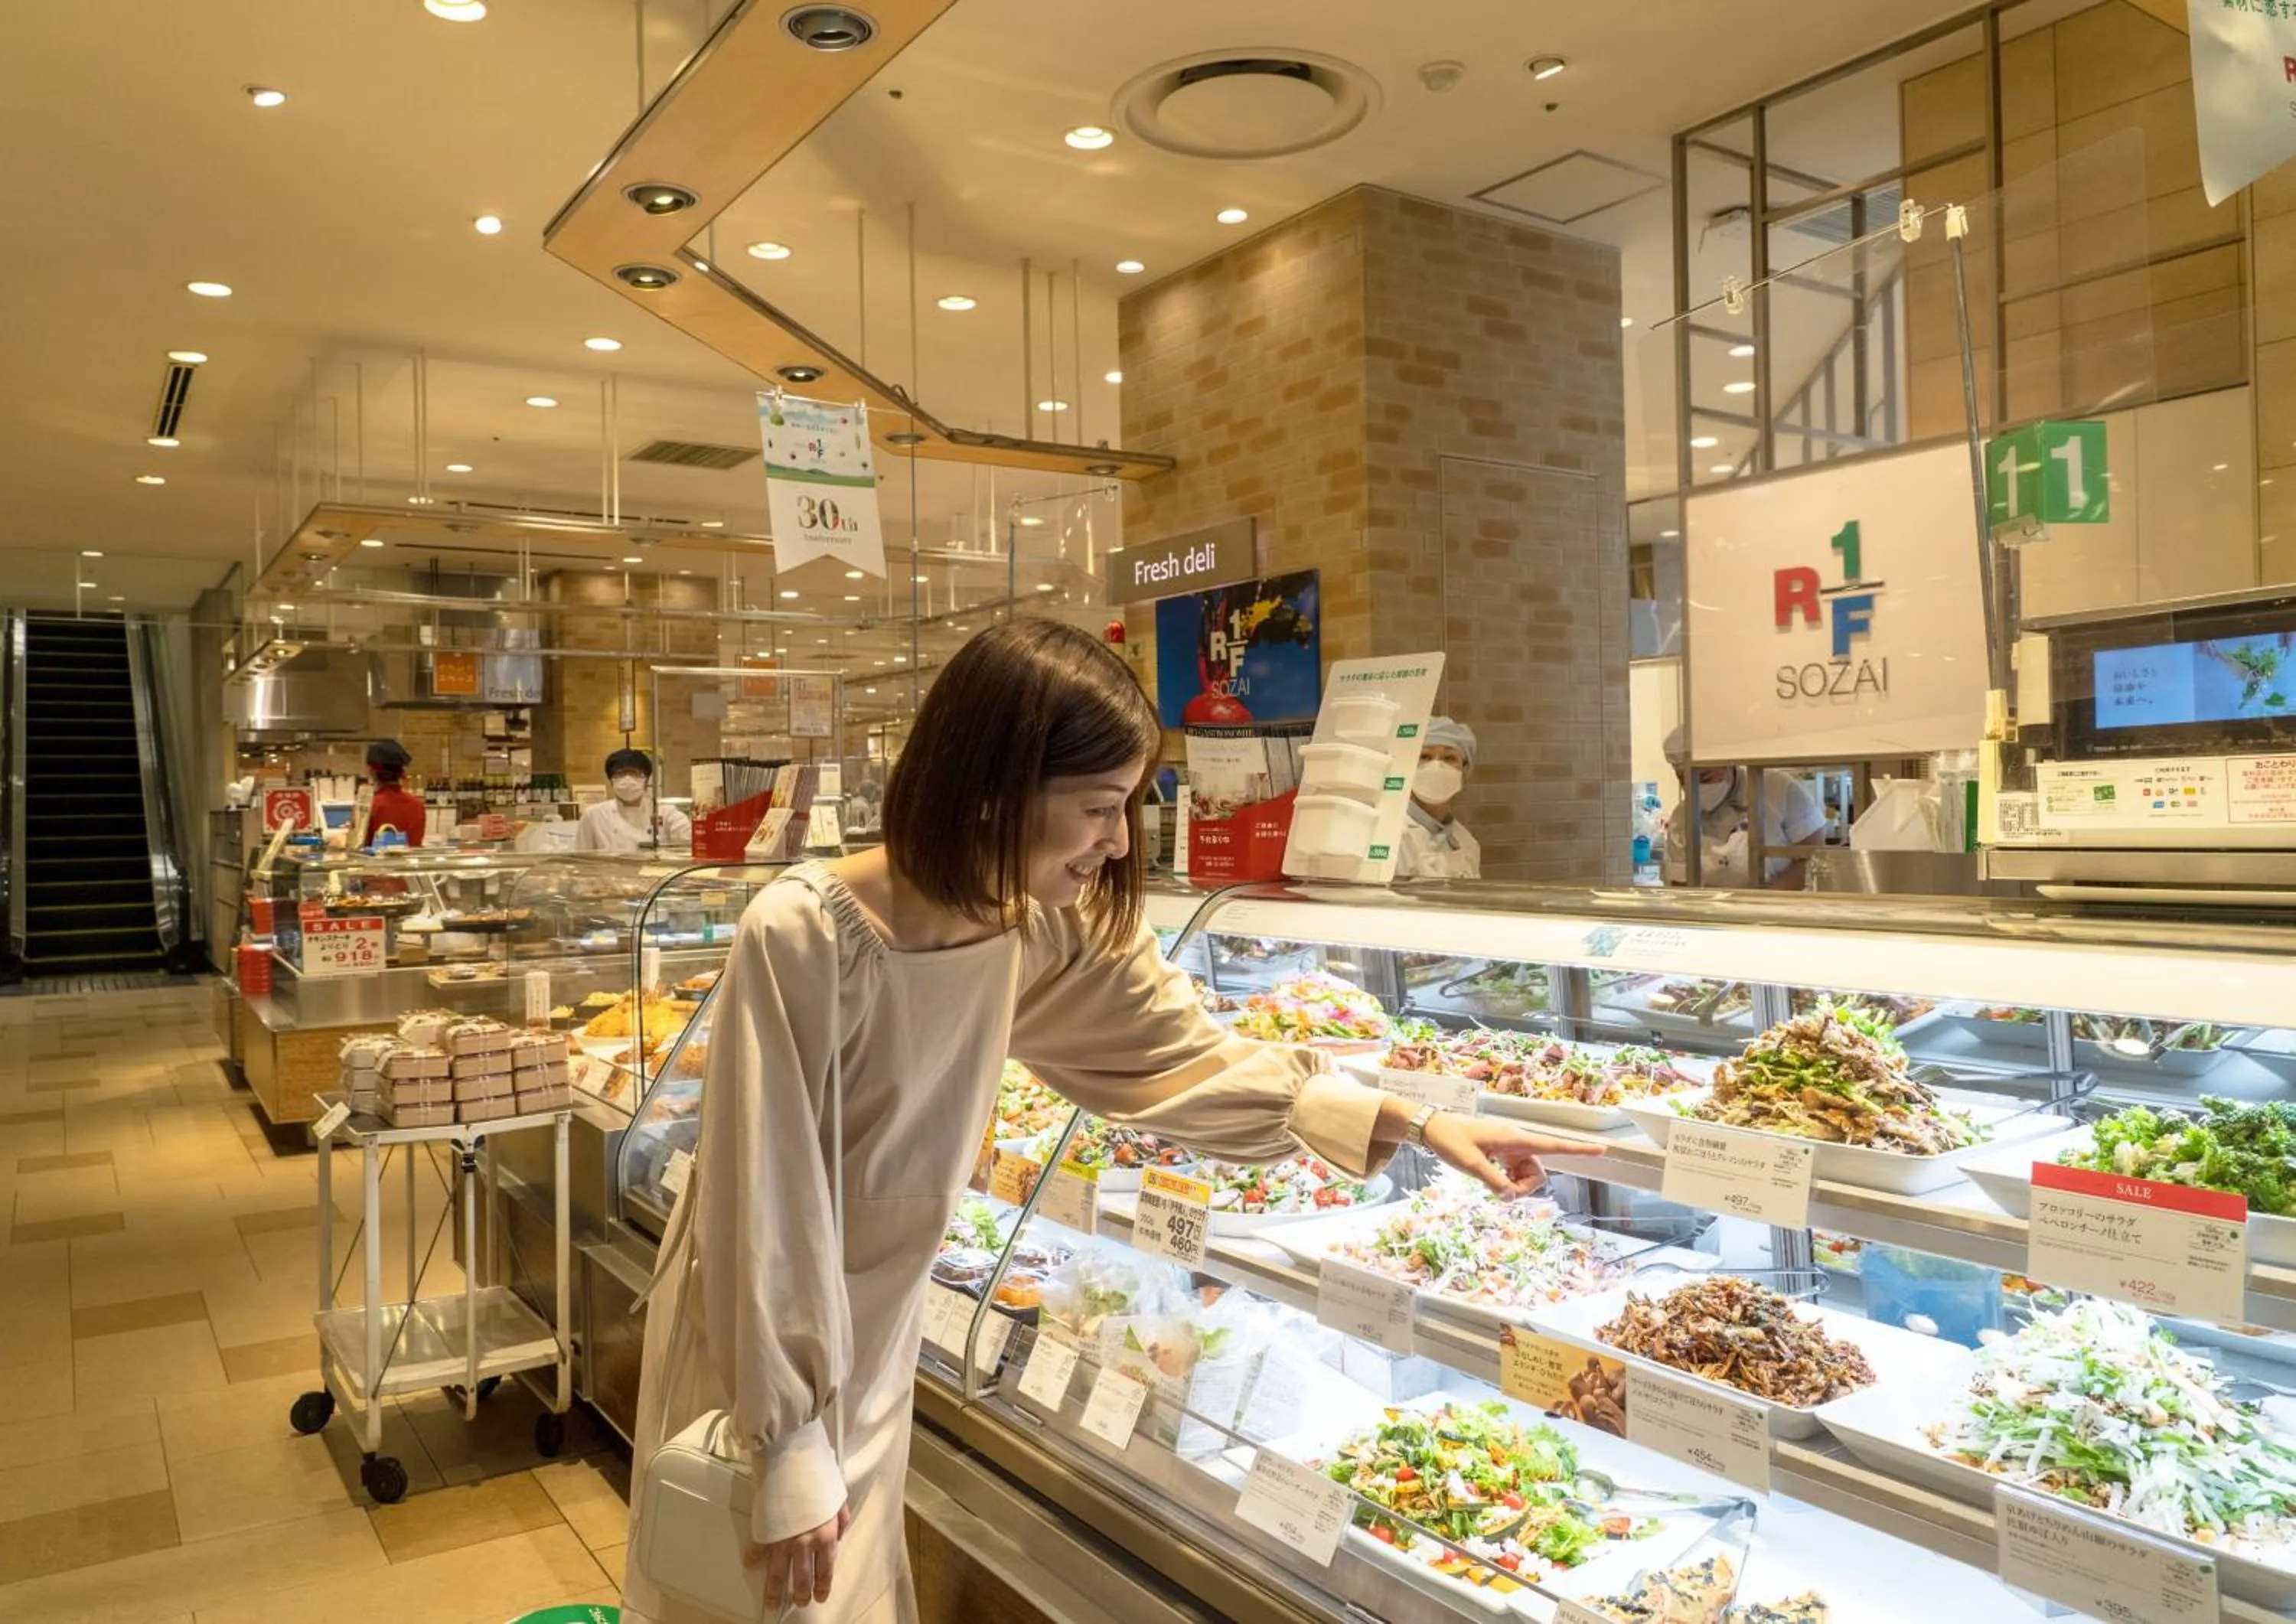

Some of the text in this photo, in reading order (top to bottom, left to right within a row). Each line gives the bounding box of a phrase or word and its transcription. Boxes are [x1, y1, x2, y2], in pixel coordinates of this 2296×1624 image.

[2051, 435, 2085, 508] 1
[1135, 542, 1215, 586] Fresh deli
[1212, 677, 1250, 699] SOZAI
[1776, 658, 1888, 700] SOZAI
[2115, 1183, 2152, 1199] SALE
[2039, 1202, 2138, 1226] ブロッコリーのサラダ
